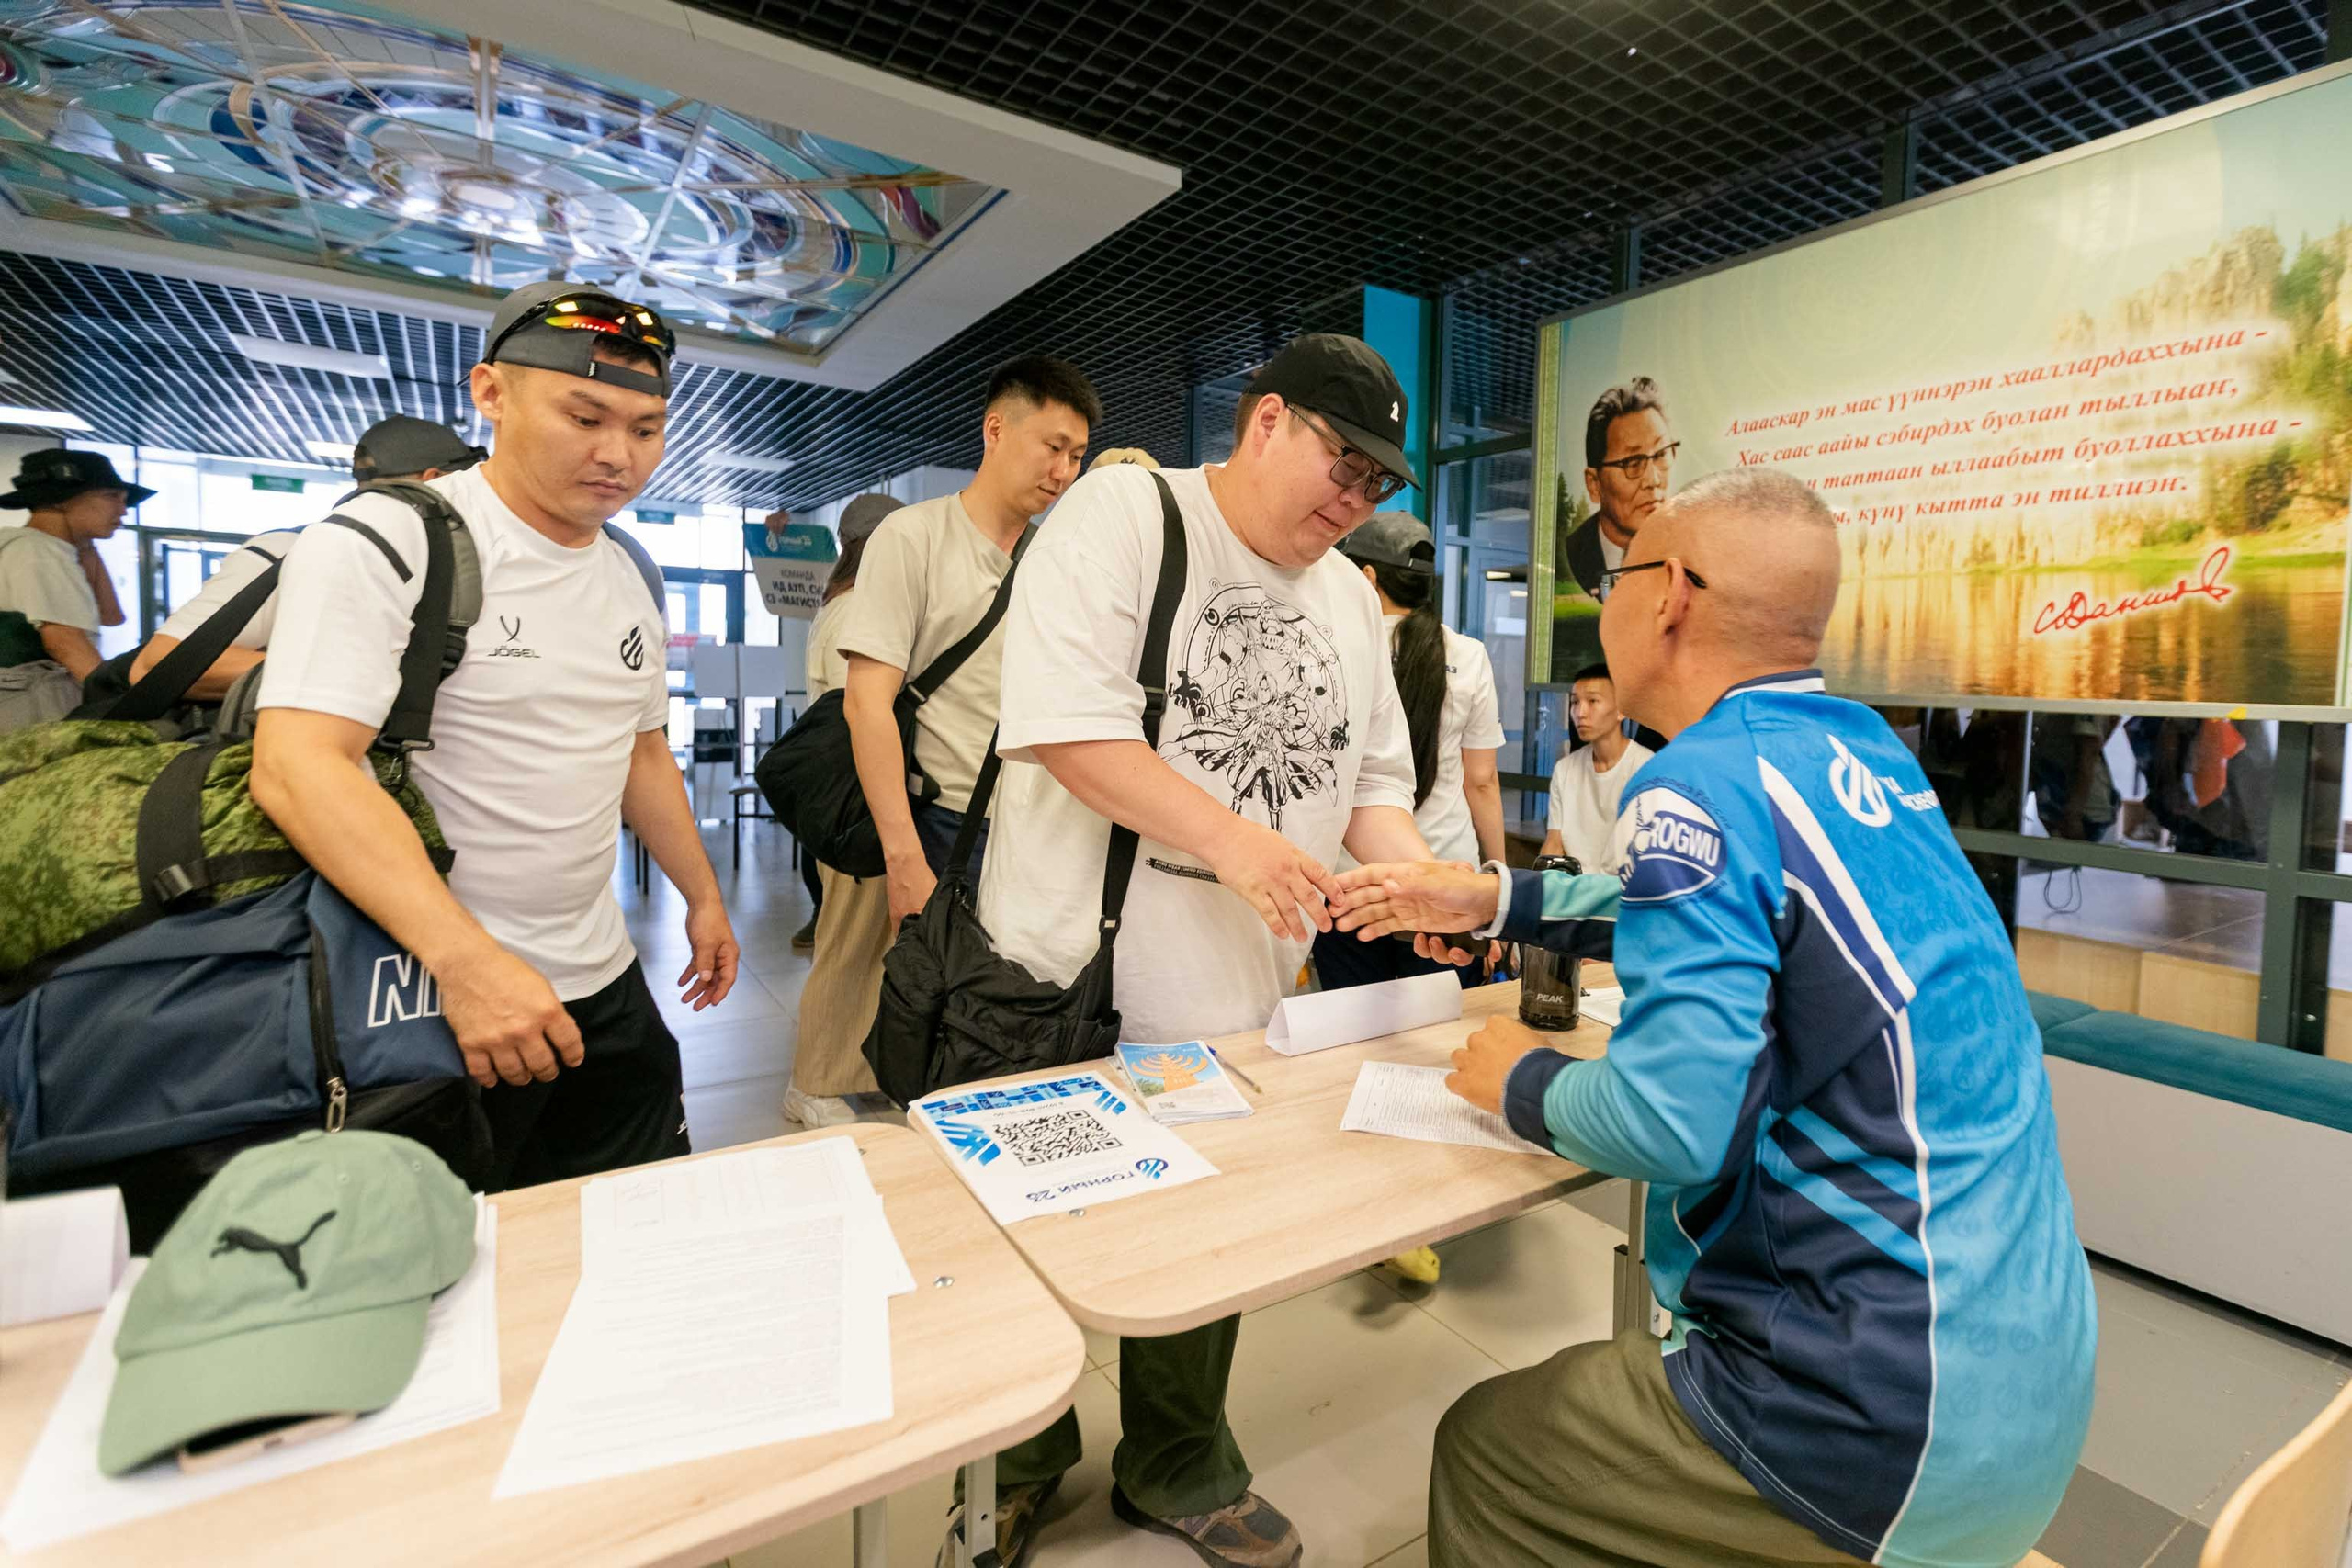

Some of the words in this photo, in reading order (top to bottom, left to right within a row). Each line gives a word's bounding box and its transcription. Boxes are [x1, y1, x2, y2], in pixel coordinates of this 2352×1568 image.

[1725, 410, 1811, 437] Алааскар
[1815, 404, 1837, 421] эн
[1840, 397, 1882, 415] мас
[1998, 329, 2247, 388] хааллардаххына
[1736, 449, 1770, 468] Хас
[1773, 445, 1814, 462] саас
[1817, 434, 1870, 455] аайы
[1875, 418, 1976, 446] сэбирдэх
[1981, 402, 2070, 435] буолан
[1822, 465, 1924, 491] таптаан
[1930, 445, 2064, 477] ыллаабыт
[2074, 416, 2278, 463] буоллаххына
[1915, 493, 2005, 516] кытта
[2011, 489, 2041, 507] эн
[487, 645, 542, 659] JÖGEL
[1651, 815, 1722, 868] ROGWU
[1536, 993, 1564, 1004] PEAK
